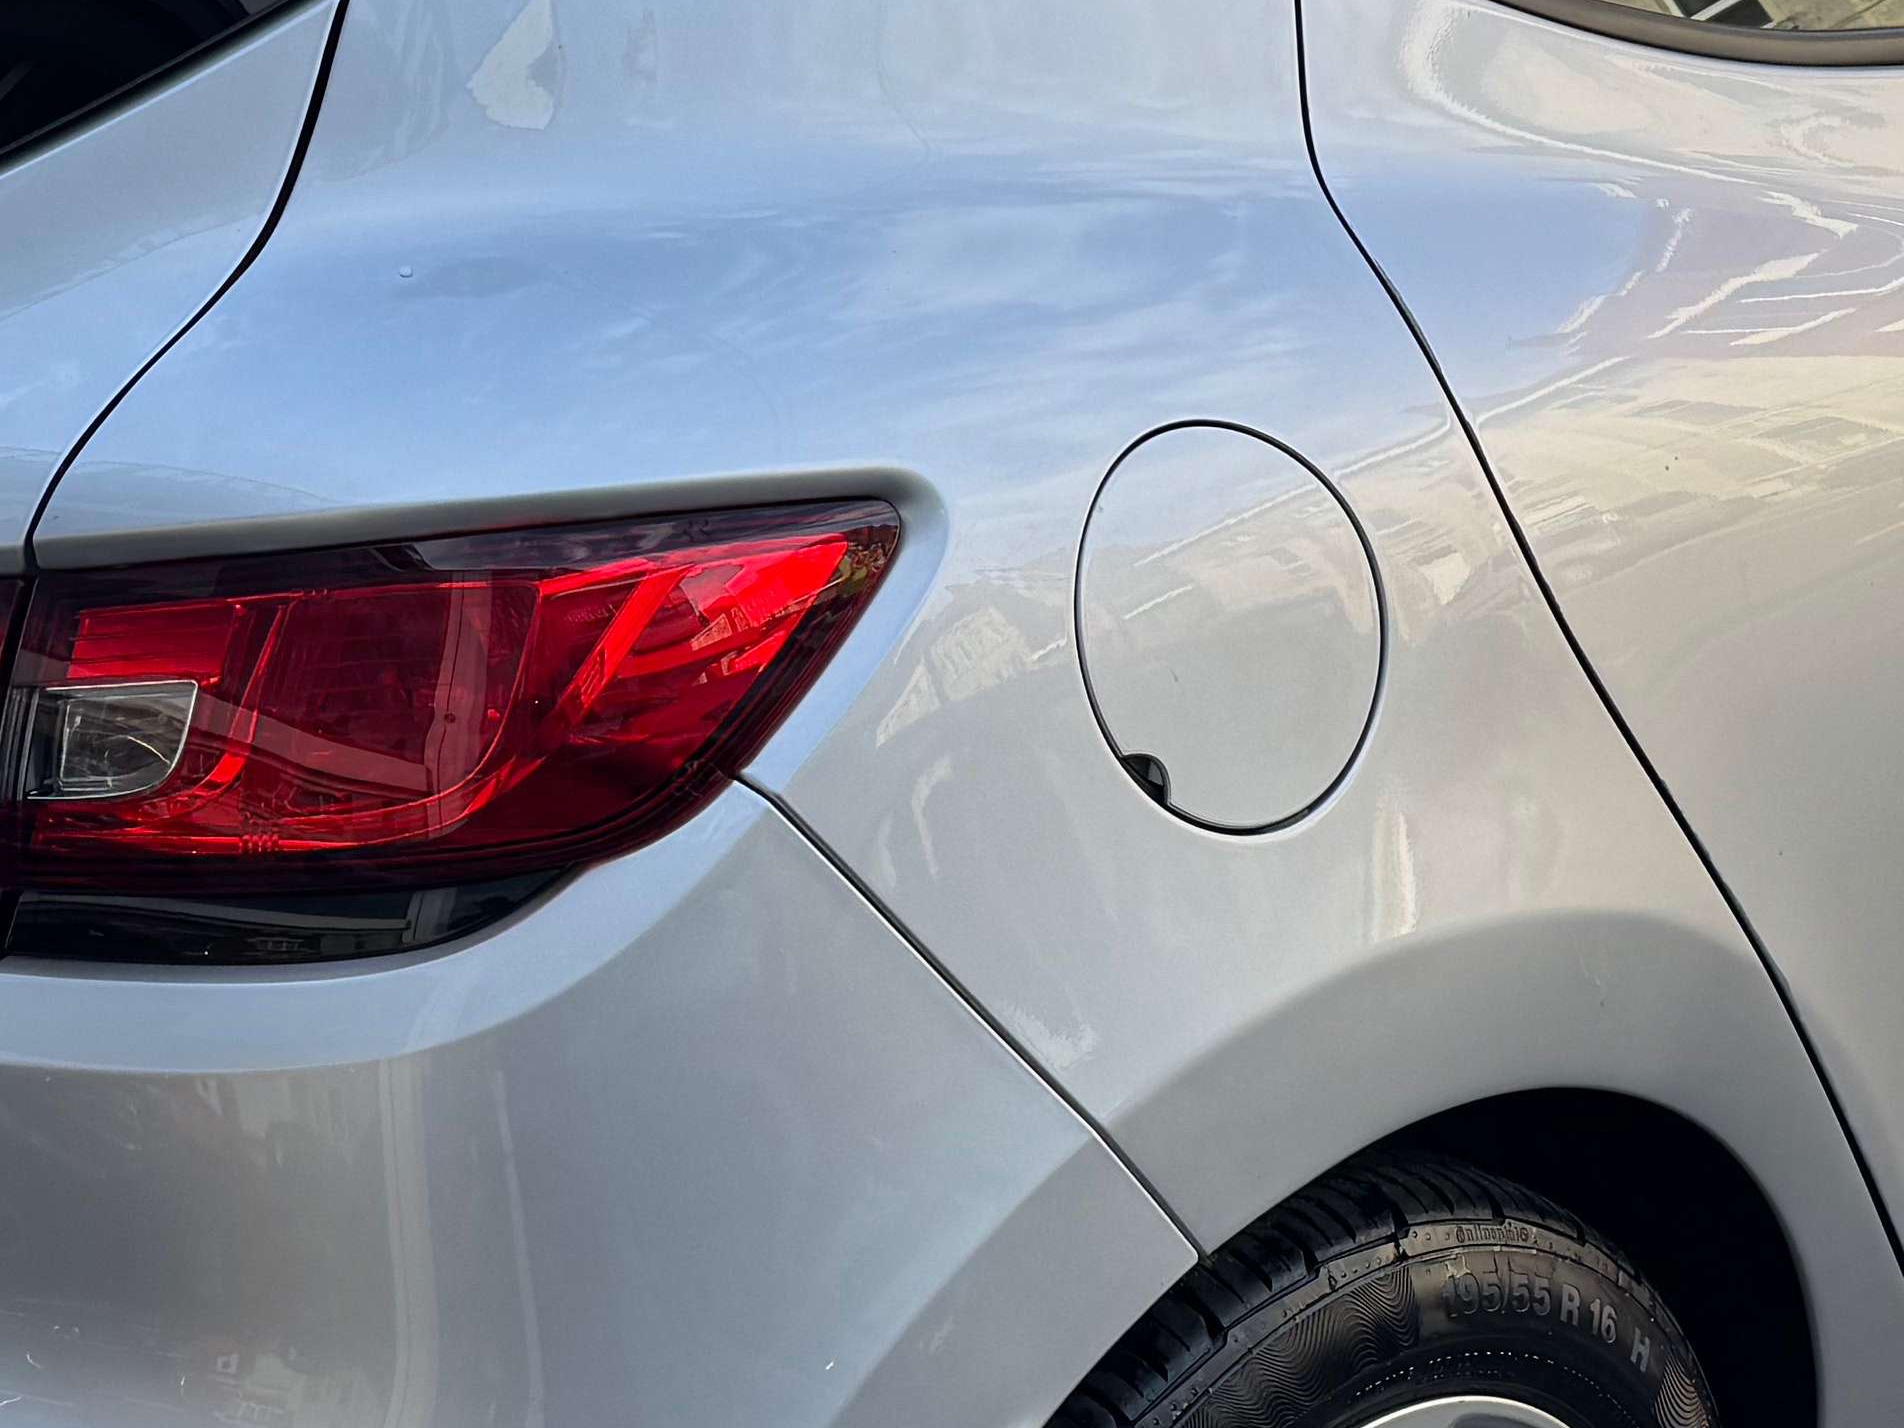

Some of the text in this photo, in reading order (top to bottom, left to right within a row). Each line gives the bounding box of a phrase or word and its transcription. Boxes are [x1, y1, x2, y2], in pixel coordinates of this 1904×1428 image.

[1560, 1283, 1581, 1326] R
[1589, 1298, 1617, 1343] 16
[1630, 1327, 1650, 1372] H
